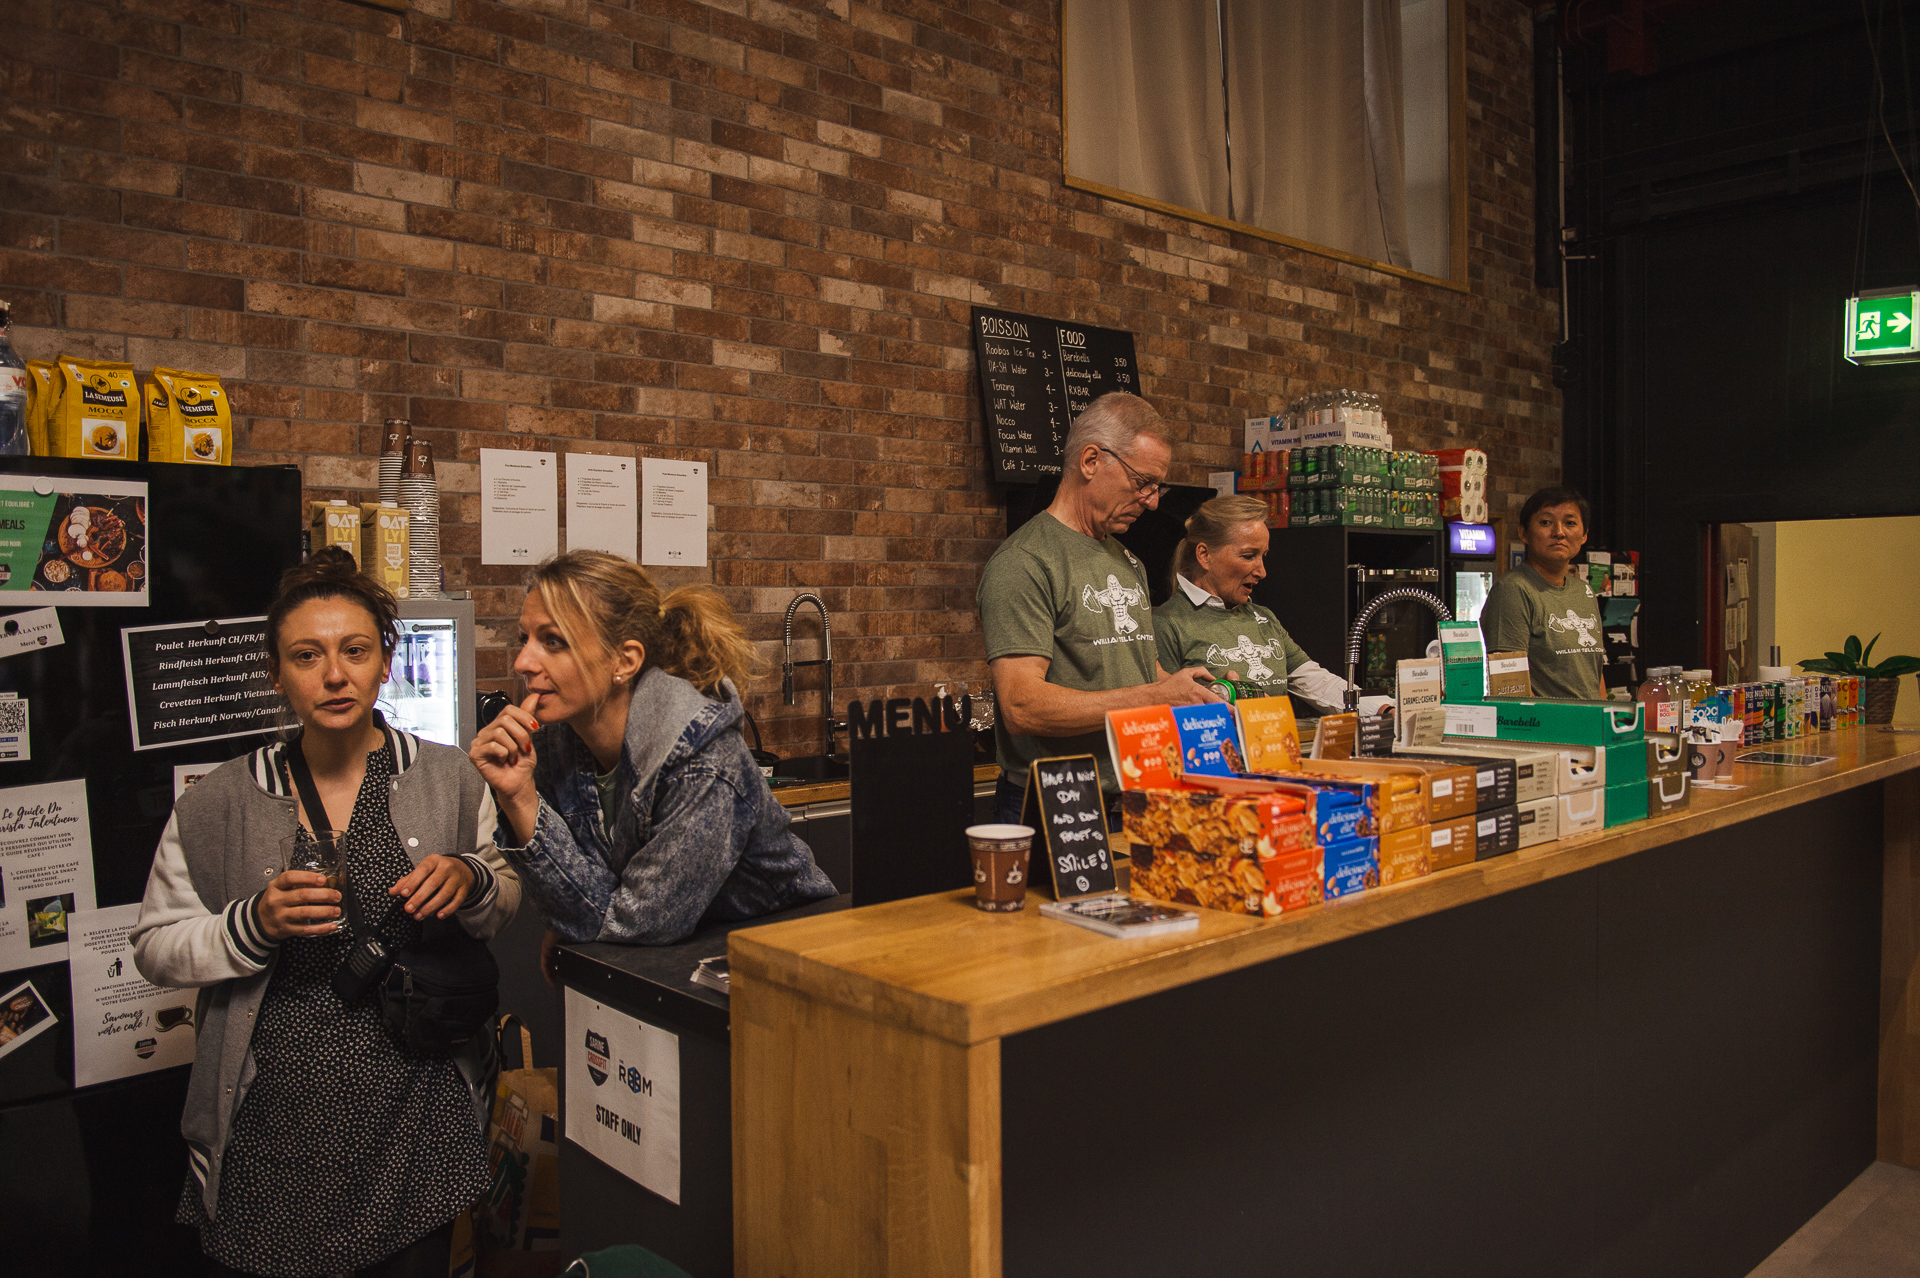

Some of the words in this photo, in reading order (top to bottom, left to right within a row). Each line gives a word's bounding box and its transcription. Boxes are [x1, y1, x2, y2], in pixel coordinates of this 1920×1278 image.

[980, 316, 1028, 338] BOISSON
[1060, 329, 1086, 345] FOOD
[1013, 346, 1023, 357] Ice
[1025, 348, 1035, 359] Tea
[1063, 350, 1090, 363] Barebells
[988, 360, 1007, 373] DA-SH
[1011, 364, 1027, 374] Water
[991, 379, 1015, 397] Tenzing
[1069, 385, 1090, 396] RXBAR
[85, 391, 93, 399] LA
[94, 394, 124, 403] SEMEUSE
[88, 407, 123, 415] MOCCA
[186, 404, 214, 413] SEMEUSE
[1009, 400, 1026, 410] Water
[996, 414, 1015, 426] Nocco
[998, 429, 1016, 440] Focus
[1018, 430, 1032, 440] Water
[1304, 432, 1327, 440] VITAMIN
[1328, 430, 1341, 438] WELL
[1352, 430, 1370, 440] VITAMIN
[1000, 442, 1022, 454] Vitamin
[1025, 444, 1037, 454] Well
[1271, 438, 1291, 446] VITAMIN
[1002, 459, 1015, 470] Café
[1459, 529, 1486, 540] VITAMIN
[1460, 540, 1476, 551] WELL
[156, 641, 184, 651] Poulet
[188, 636, 227, 648] Herkunft
[228, 633, 265, 644] CH/FR/B
[159, 659, 203, 670] Rindfleish
[205, 654, 243, 666] Herkunft
[153, 678, 208, 691] Lammfleisch
[211, 672, 248, 684] Herkunft
[250, 670, 270, 679] AUS/
[160, 698, 202, 709] Crevetten
[204, 692, 242, 704] Herkunft
[244, 688, 278, 698] Vietnam
[154, 720, 177, 730] Fisch
[179, 714, 218, 726] Herkunft
[848, 694, 972, 740] MENU
[1497, 716, 1540, 728] Barebells
[1041, 771, 1064, 788] HAVE
[1066, 771, 1074, 783] A
[1056, 790, 1080, 804] DAY
[2, 808, 14, 820] Le
[17, 805, 45, 822] Guide
[48, 802, 62, 815] Du
[6, 842, 36, 851] PERSONNES
[49, 837, 74, 845] UTILISENT
[16, 867, 46, 876] CHOISISSEZ
[18, 883, 44, 891] ESPRESSO
[102, 982, 125, 991] MACHINE
[126, 979, 145, 987] PERMET
[103, 1009, 144, 1024] Savourez
[98, 1023, 121, 1036] votre
[124, 1020, 143, 1032] café
[589, 1036, 604, 1053] SABINE
[588, 1051, 607, 1070] CROSSFIT
[596, 1104, 619, 1132] STAFF
[621, 1118, 641, 1146] ONLY
